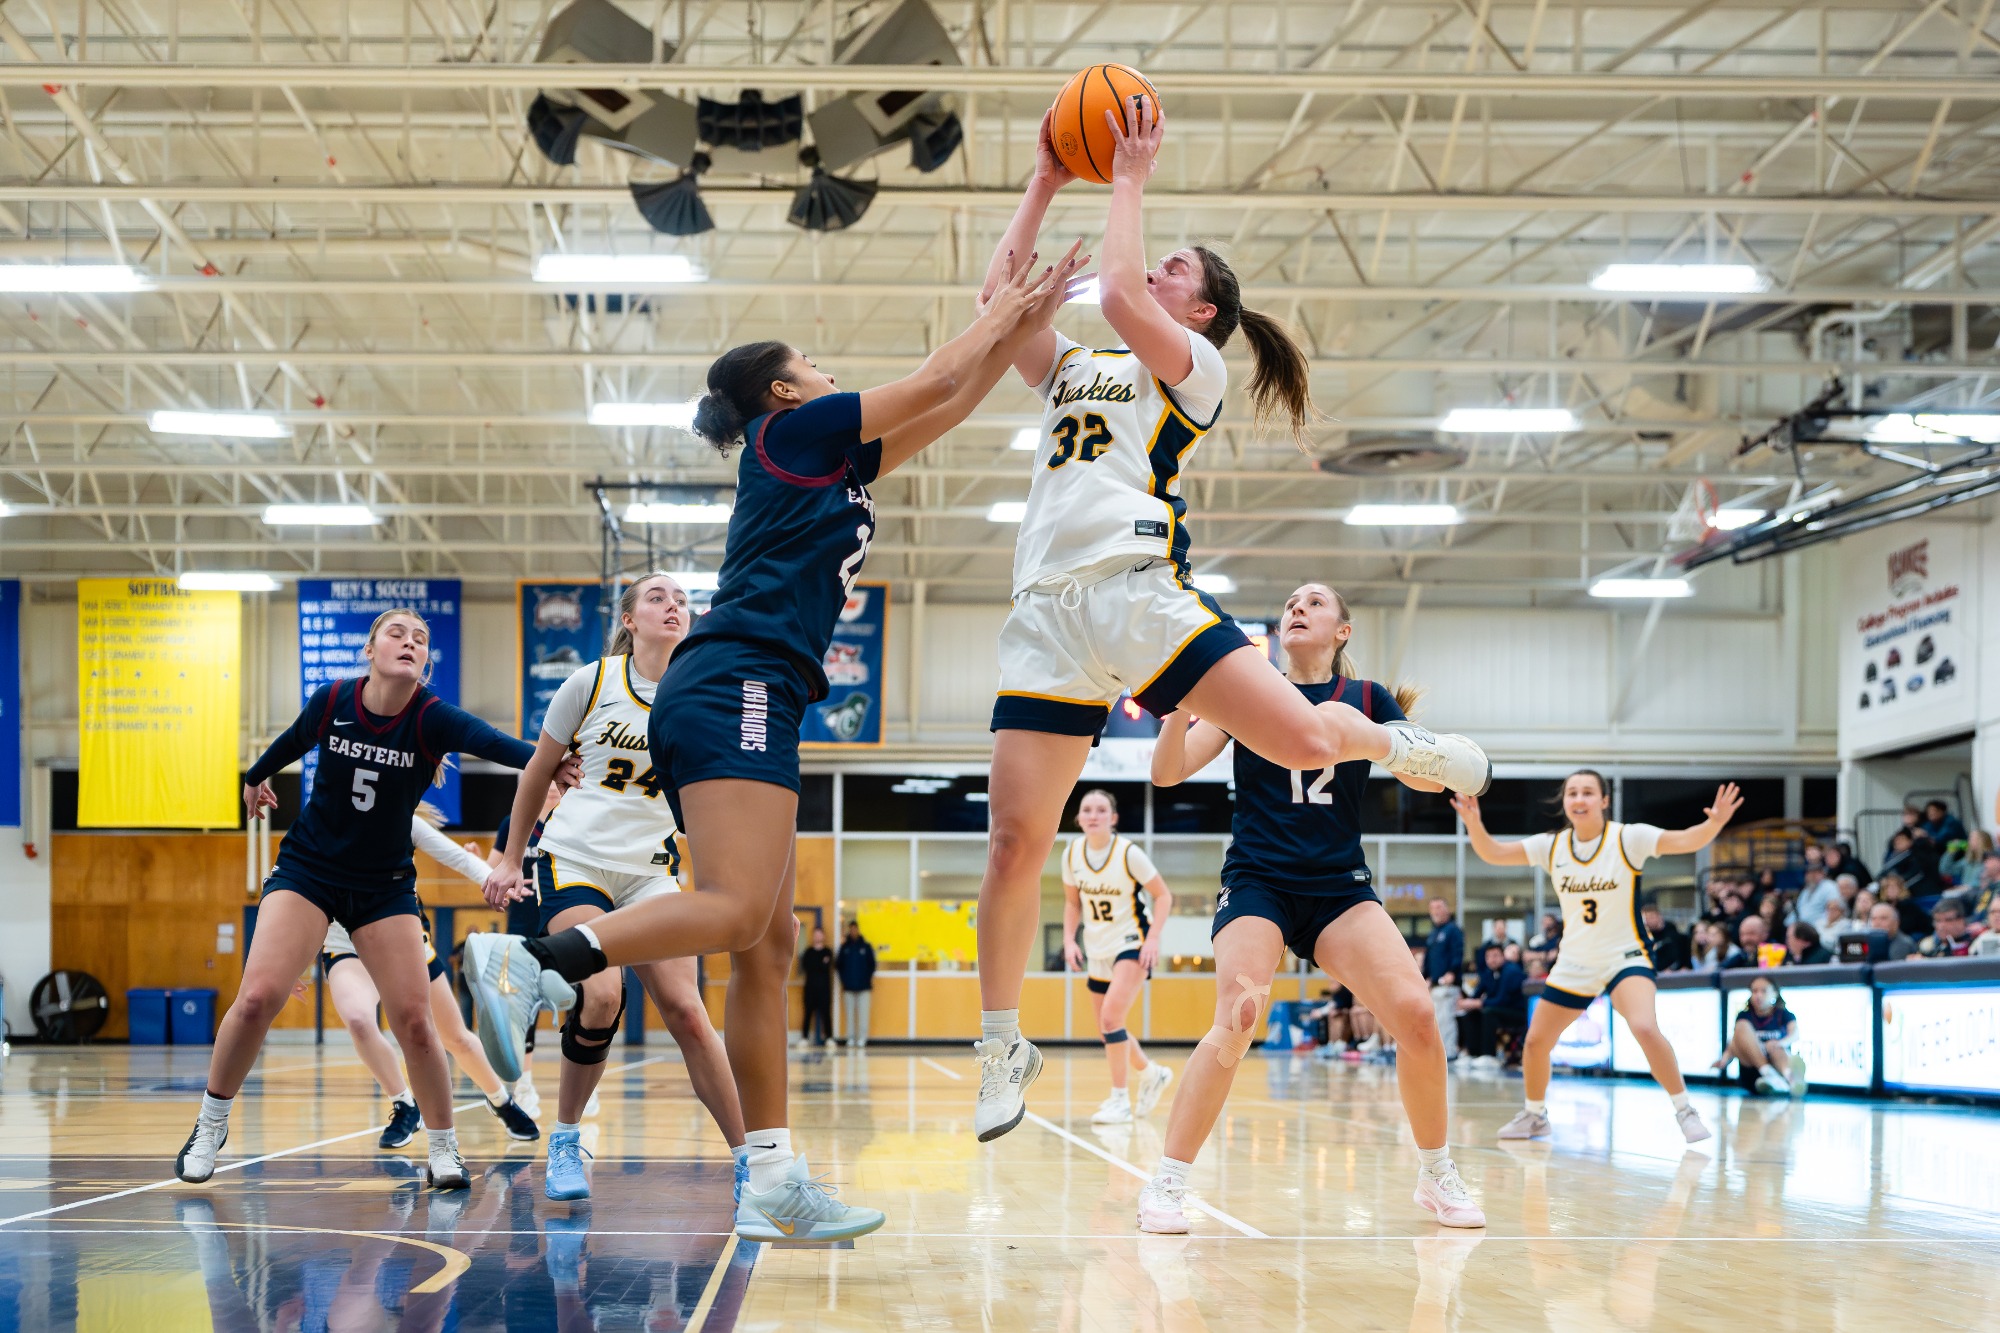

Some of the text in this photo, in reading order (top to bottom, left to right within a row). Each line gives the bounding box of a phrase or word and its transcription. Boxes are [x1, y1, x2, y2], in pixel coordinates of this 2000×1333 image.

[1046, 411, 1114, 471] 32
[375, 581, 428, 599] SOCCER
[740, 680, 768, 752] WARRIORS
[328, 735, 415, 768] EASTERN
[351, 767, 379, 812] 5
[600, 757, 663, 799] 24
[1290, 765, 1335, 804] 12
[1078, 879, 1122, 896] Huskies
[1560, 875, 1618, 893] Huskies
[1088, 899, 1114, 922] 12
[1581, 898, 1598, 924] 3
